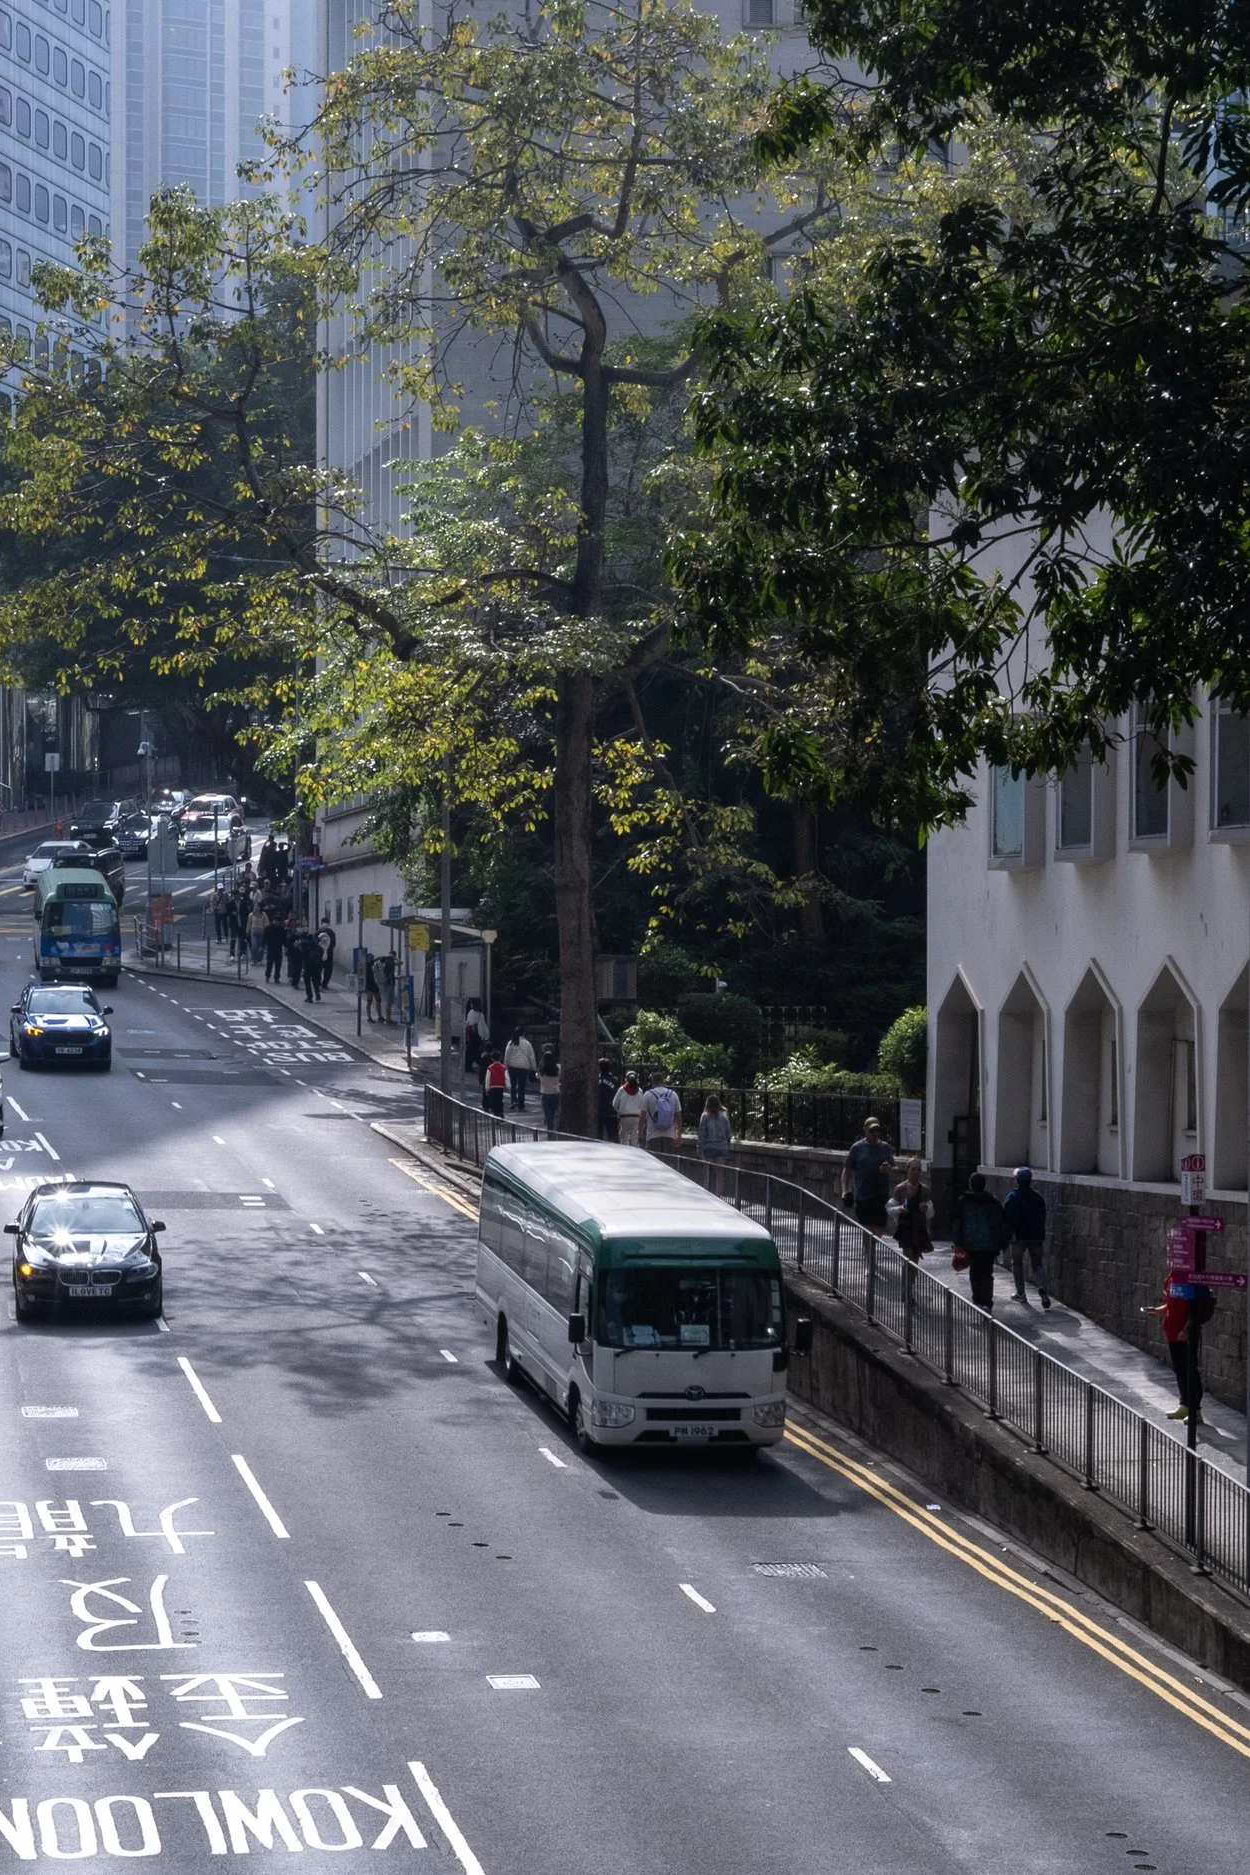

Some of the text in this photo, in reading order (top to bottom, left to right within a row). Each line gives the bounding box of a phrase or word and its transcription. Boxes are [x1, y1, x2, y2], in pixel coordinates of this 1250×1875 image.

[245, 1040, 344, 1050] STOP
[265, 1051, 355, 1063] BUS
[59, 1574, 198, 1651] 及
[18, 1673, 306, 1763] 金鐘
